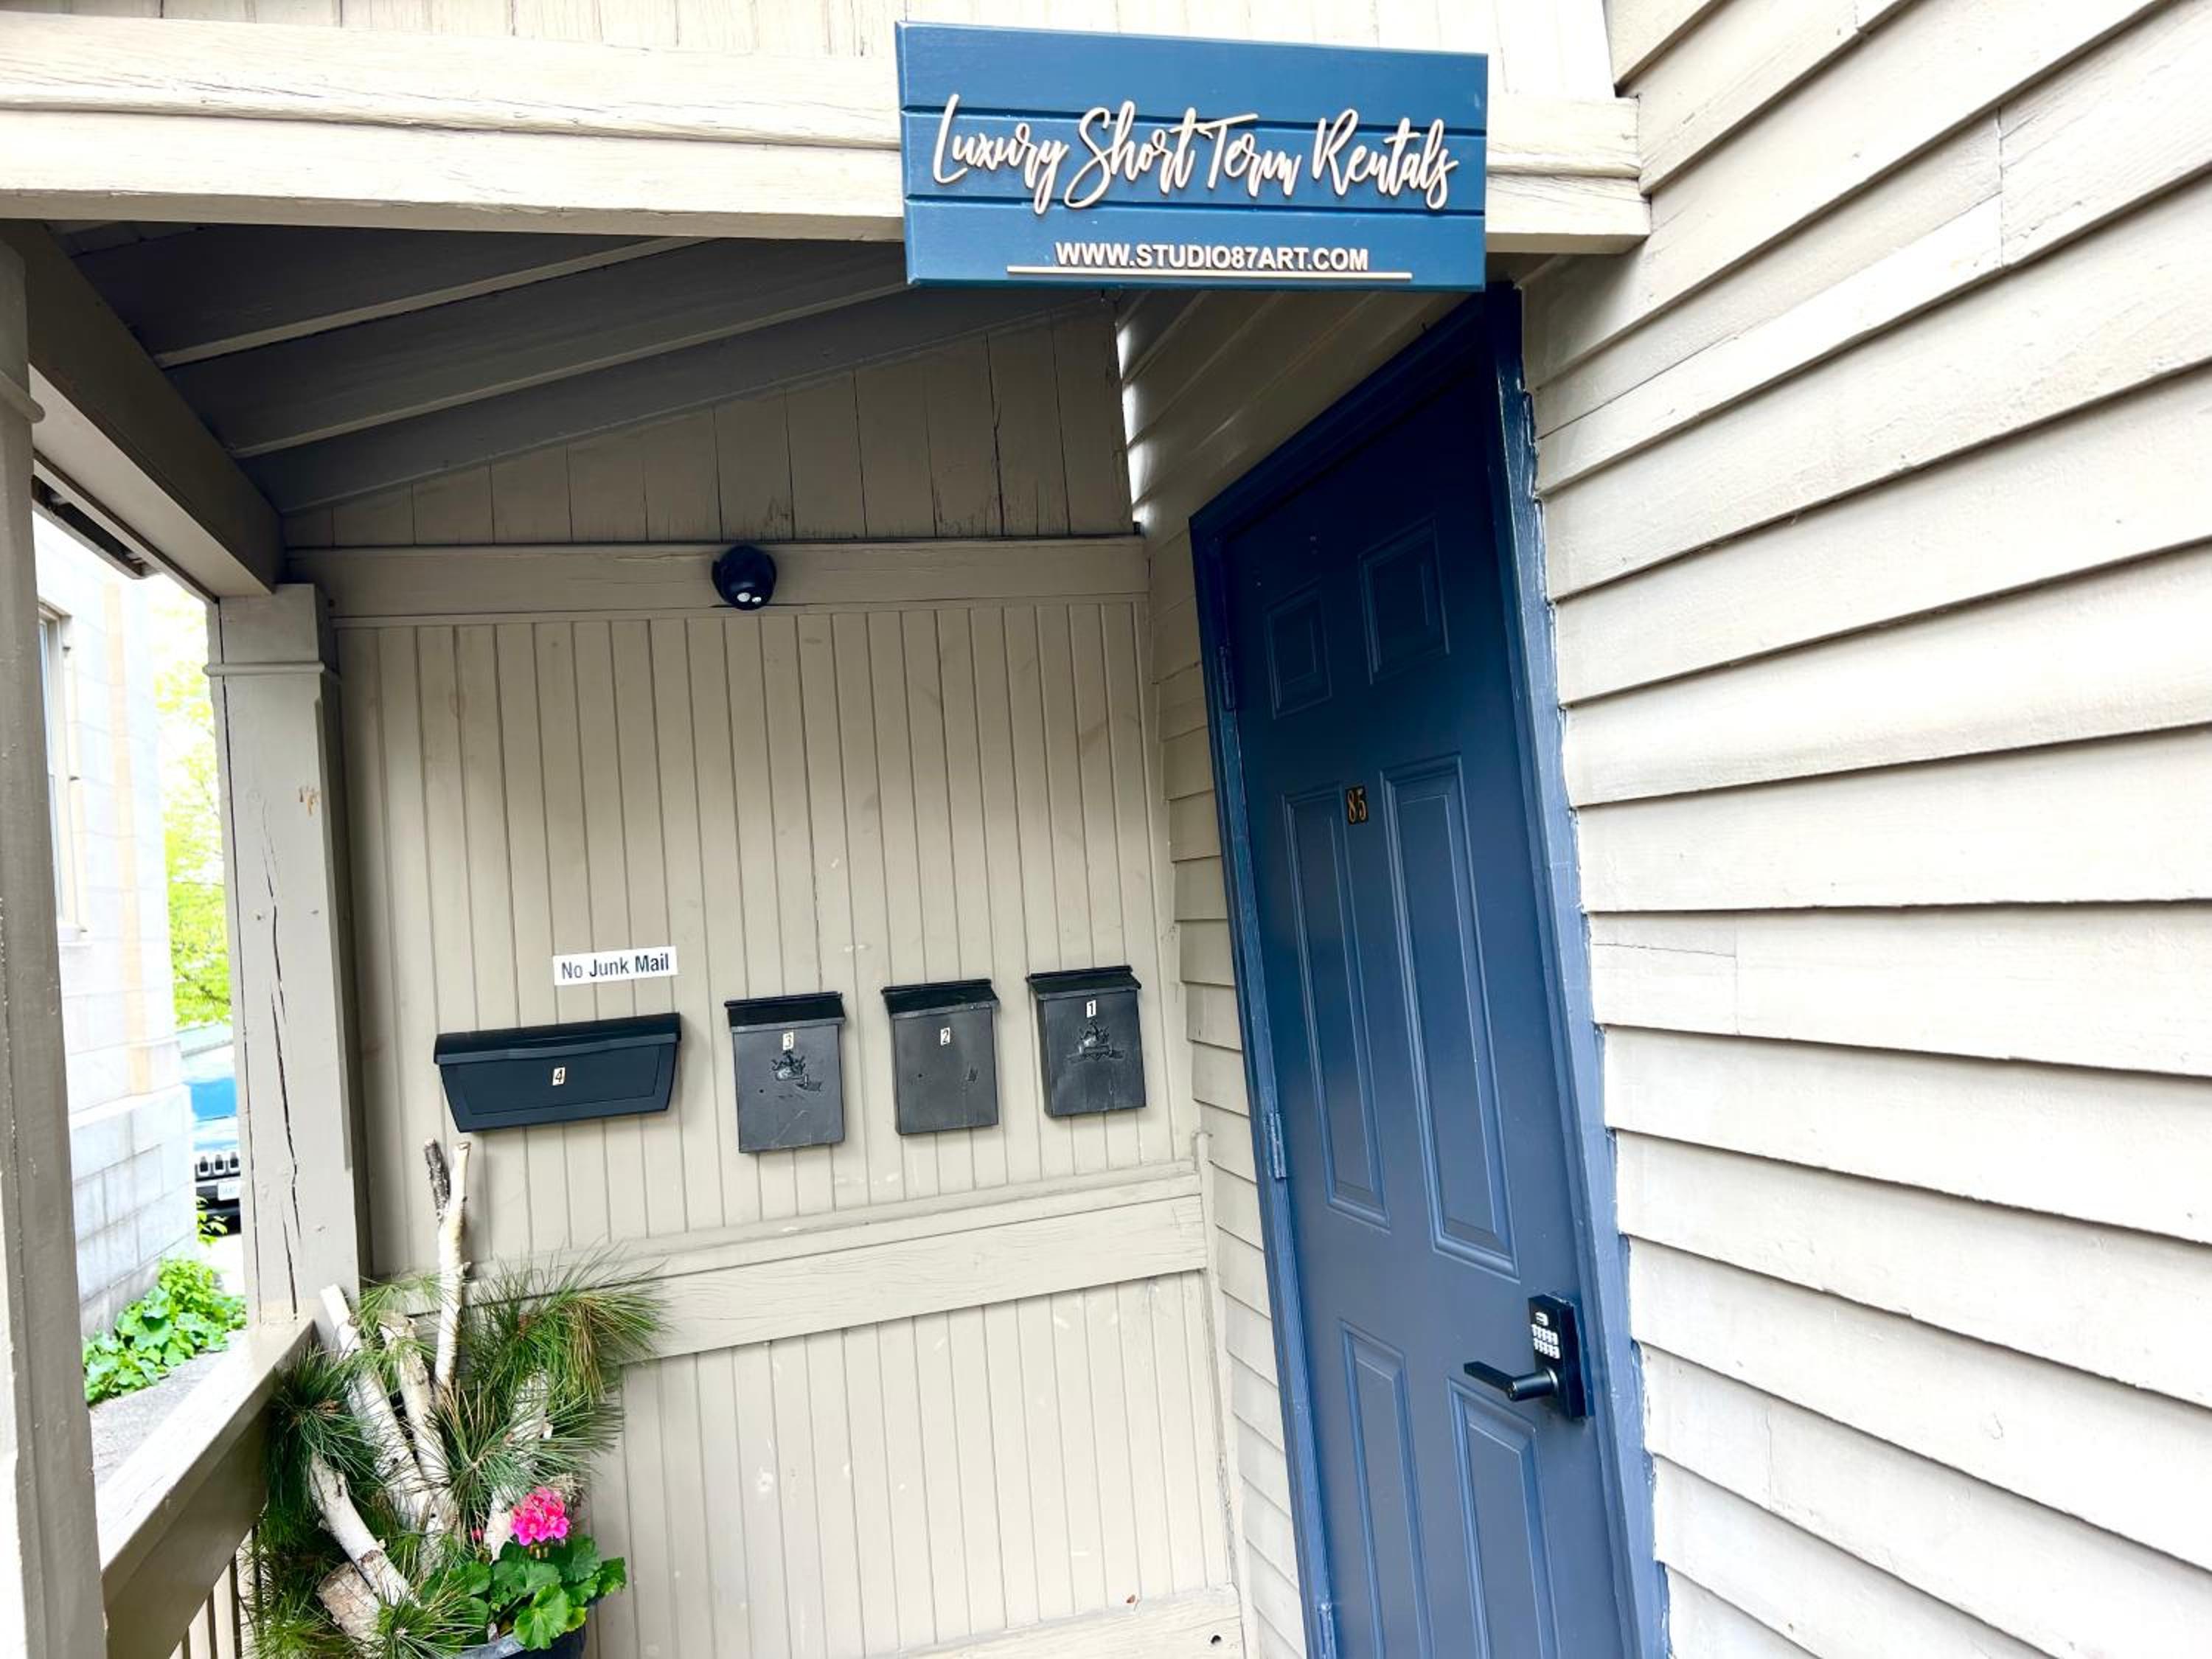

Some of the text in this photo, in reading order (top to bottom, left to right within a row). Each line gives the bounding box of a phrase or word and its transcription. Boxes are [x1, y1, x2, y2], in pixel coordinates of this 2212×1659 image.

[932, 93, 1459, 215] Luxury Short Term Rentals
[1054, 241, 1370, 271] WWW.STUDIO87ART.COM
[1347, 788, 1367, 824] 85
[561, 953, 669, 979] No Junk Mail
